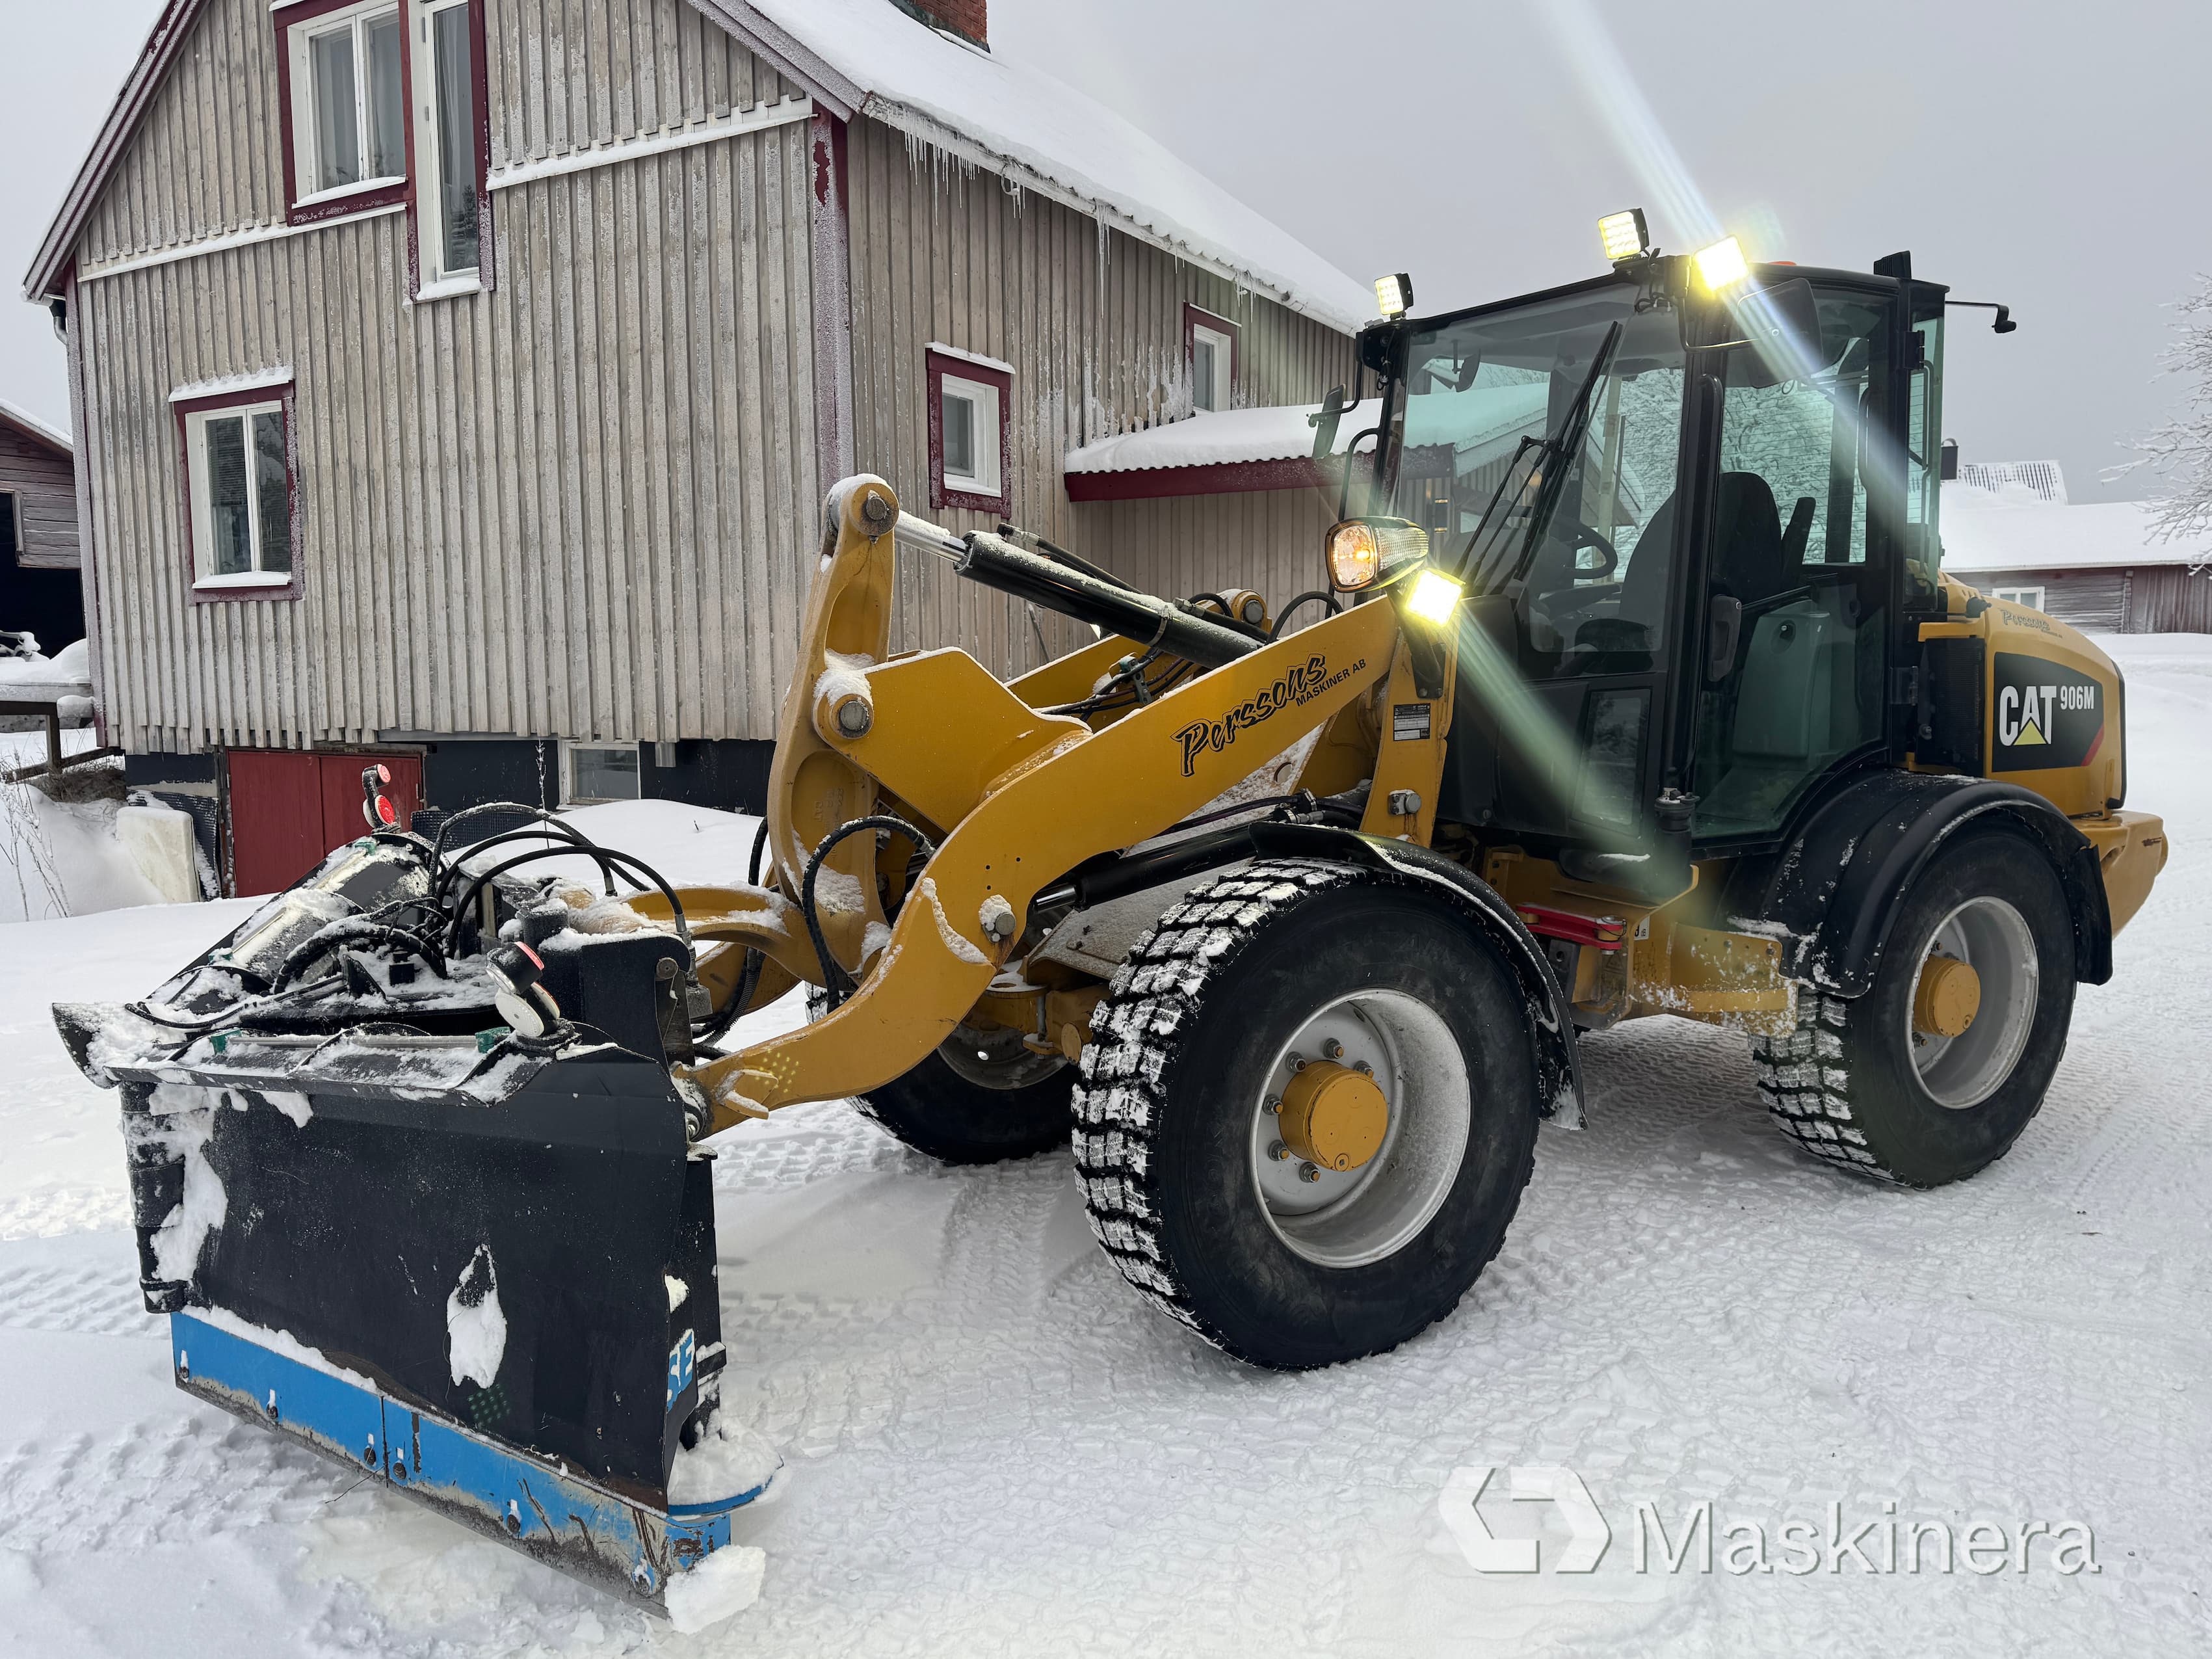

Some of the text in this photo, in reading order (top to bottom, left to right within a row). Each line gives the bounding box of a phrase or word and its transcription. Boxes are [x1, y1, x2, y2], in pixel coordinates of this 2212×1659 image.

[1295, 658, 1367, 707] MASKINER AB
[1170, 654, 1326, 777] Perssons
[1999, 685, 2095, 747] CAT 906M
